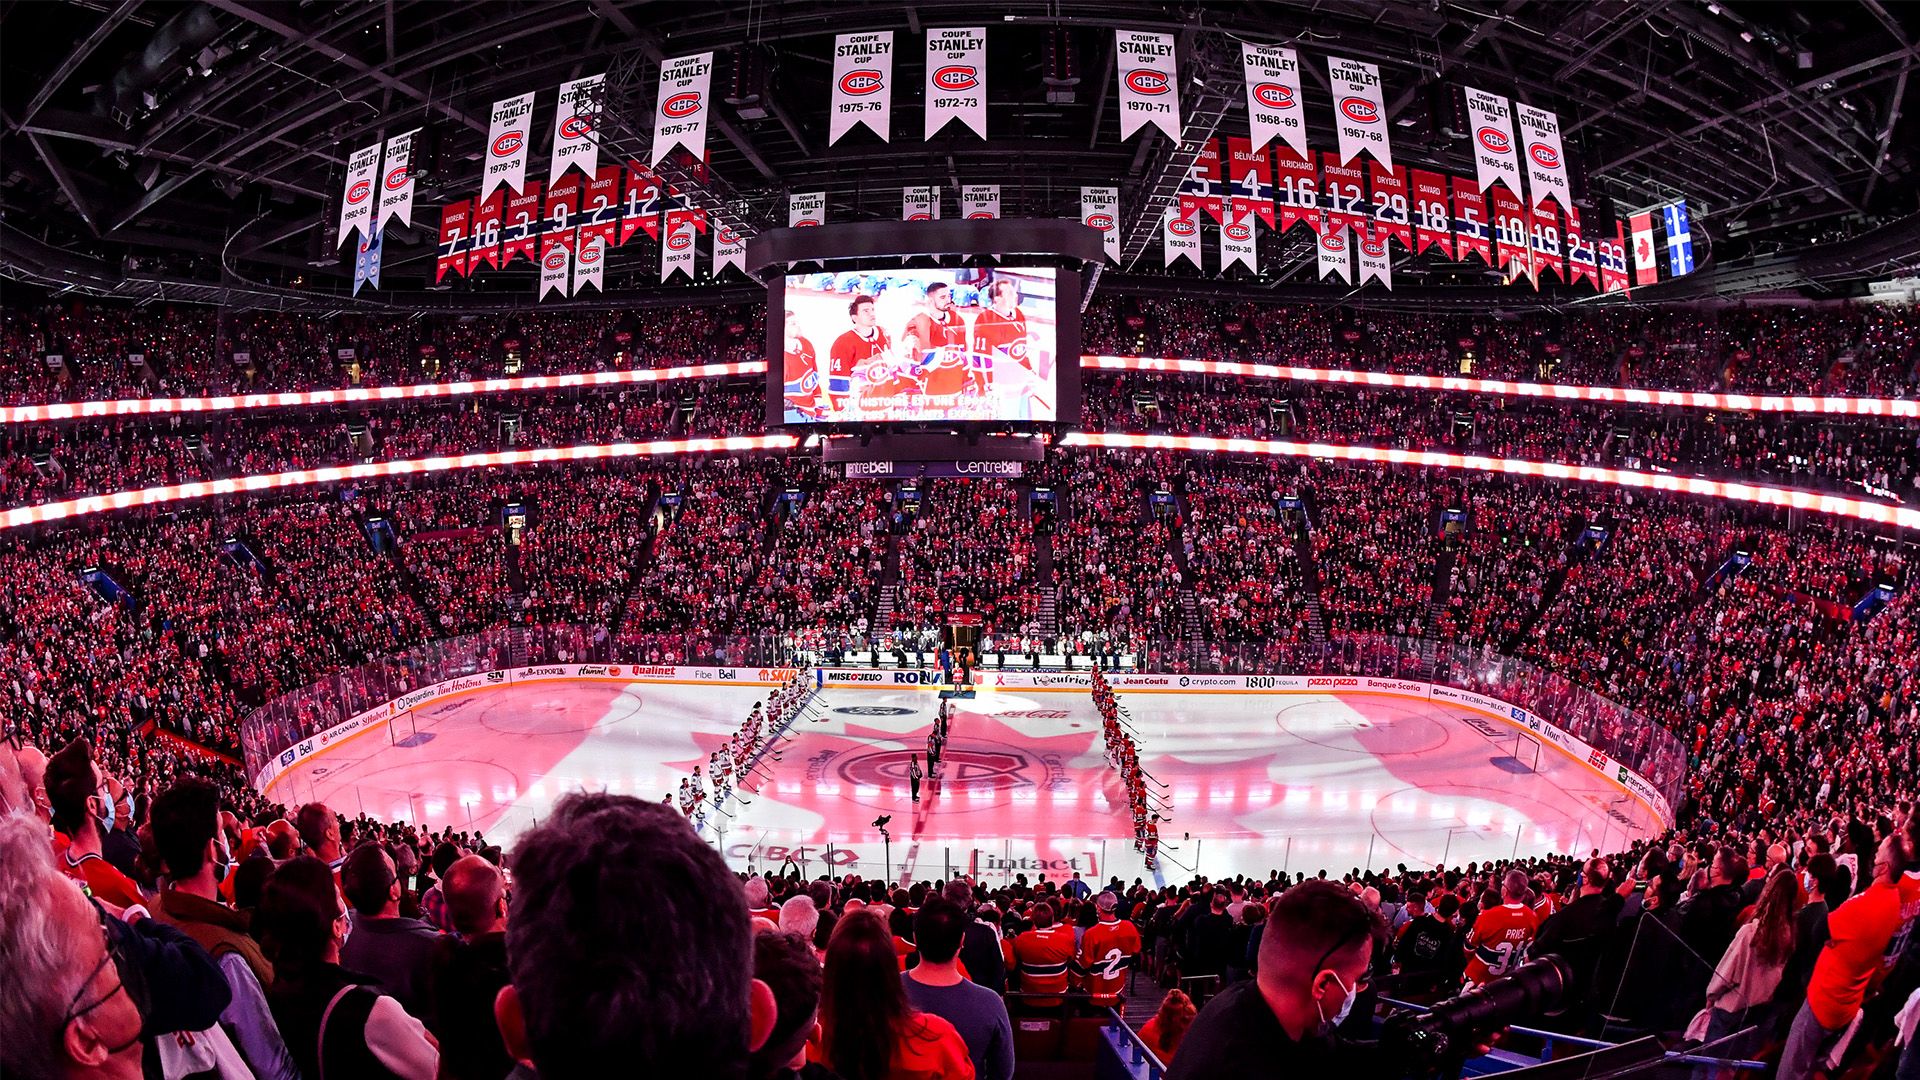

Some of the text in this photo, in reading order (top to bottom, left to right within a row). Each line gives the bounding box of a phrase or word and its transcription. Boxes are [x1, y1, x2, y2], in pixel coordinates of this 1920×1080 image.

[850, 34, 880, 44] COUPE
[941, 30, 972, 38] COUPE
[1130, 34, 1160, 42] COUPE
[837, 42, 890, 56] STANLEY
[929, 38, 984, 51] STANLEY
[1120, 42, 1172, 56] STANLEY
[1256, 47, 1284, 57] COUPE
[674, 57, 700, 68] COUPE
[854, 56, 872, 64] CUP
[1246, 54, 1296, 71] STANLEY
[662, 63, 710, 82] STANLEY
[1264, 69, 1280, 77] CUP
[1332, 68, 1378, 86] STANLEY
[676, 79, 692, 88] CUP
[1349, 84, 1365, 92] CUP
[503, 98, 524, 108] COUPE
[934, 98, 978, 108] 1972-73
[1476, 93, 1498, 104] COUPE
[492, 102, 532, 123] STANLEY
[838, 102, 882, 113] 1975-76
[1126, 100, 1170, 113] 1970-71
[1469, 98, 1508, 118] STANLEY
[1255, 113, 1298, 128] 1968-69
[1484, 114, 1498, 122] CUP
[1526, 108, 1548, 120] COUPE
[504, 119, 516, 127] CUP
[660, 122, 700, 136] 1976-77
[1520, 114, 1556, 134] STANLEY
[1343, 128, 1382, 142] 1967-68
[1535, 130, 1547, 138] CUP
[558, 142, 592, 157] 1977-78
[349, 152, 378, 173] STANLEY
[490, 160, 520, 174] 1978-79
[1280, 160, 1314, 170] H.RICHARD
[1480, 156, 1514, 172] 1965-66
[1325, 165, 1362, 178] COURNOYER
[590, 178, 612, 190] HARVEY
[1190, 166, 1210, 198] 5
[1242, 169, 1263, 201] 4
[1376, 176, 1400, 187] DRYDEN
[1533, 171, 1564, 187] 1964-65
[964, 192, 998, 202] STANLEY
[1283, 176, 1316, 210] 16
[1418, 184, 1440, 196] SAVARD
[1457, 190, 1482, 204] LAPOINTE
[510, 194, 538, 208] BOUCHARD
[626, 186, 658, 219] 12
[791, 200, 824, 210] STANLEY
[1082, 194, 1117, 204] STANLEY
[1330, 182, 1363, 216] 12
[1497, 199, 1520, 211] LAFLEUR
[344, 206, 368, 220] 1992-93
[592, 194, 608, 226] 2
[1374, 191, 1408, 225] 29
[552, 202, 568, 232] 9
[1418, 200, 1448, 233] 18
[1464, 207, 1481, 239] 5
[514, 211, 528, 241] 3
[1498, 215, 1526, 248] 10
[474, 218, 499, 250] 16
[1534, 224, 1560, 256] 19
[447, 228, 460, 257] 7
[1169, 240, 1196, 248] 1930-31
[1224, 244, 1252, 253] 1929-30
[666, 254, 690, 262] 1957-58
[1321, 255, 1346, 264] 1923-24
[1362, 260, 1386, 270] 1915-16
[1600, 242, 1626, 274] 33
[975, 336, 986, 351] 11
[830, 358, 842, 372] 14
[487, 671, 504, 680] SN
[632, 666, 676, 675] Qualinet
[694, 668, 736, 680] Fibe Bell
[436, 680, 482, 696] Tim Hortons
[1192, 678, 1236, 686] crypto.com
[1245, 676, 1275, 688] 1800
[1308, 678, 1358, 688] pizza pizza
[1368, 680, 1420, 692] Banque Scotia
[406, 690, 434, 704] Desjardins
[1514, 710, 1523, 720] 5G
[329, 720, 360, 740] AIR CANADA
[1530, 716, 1541, 731] Bell
[299, 740, 314, 756] Bell
[1620, 772, 1654, 800] enterprise
[726, 844, 816, 862] CIBC
[1505, 928, 1526, 939] PRICE
[1103, 948, 1122, 980] 2
